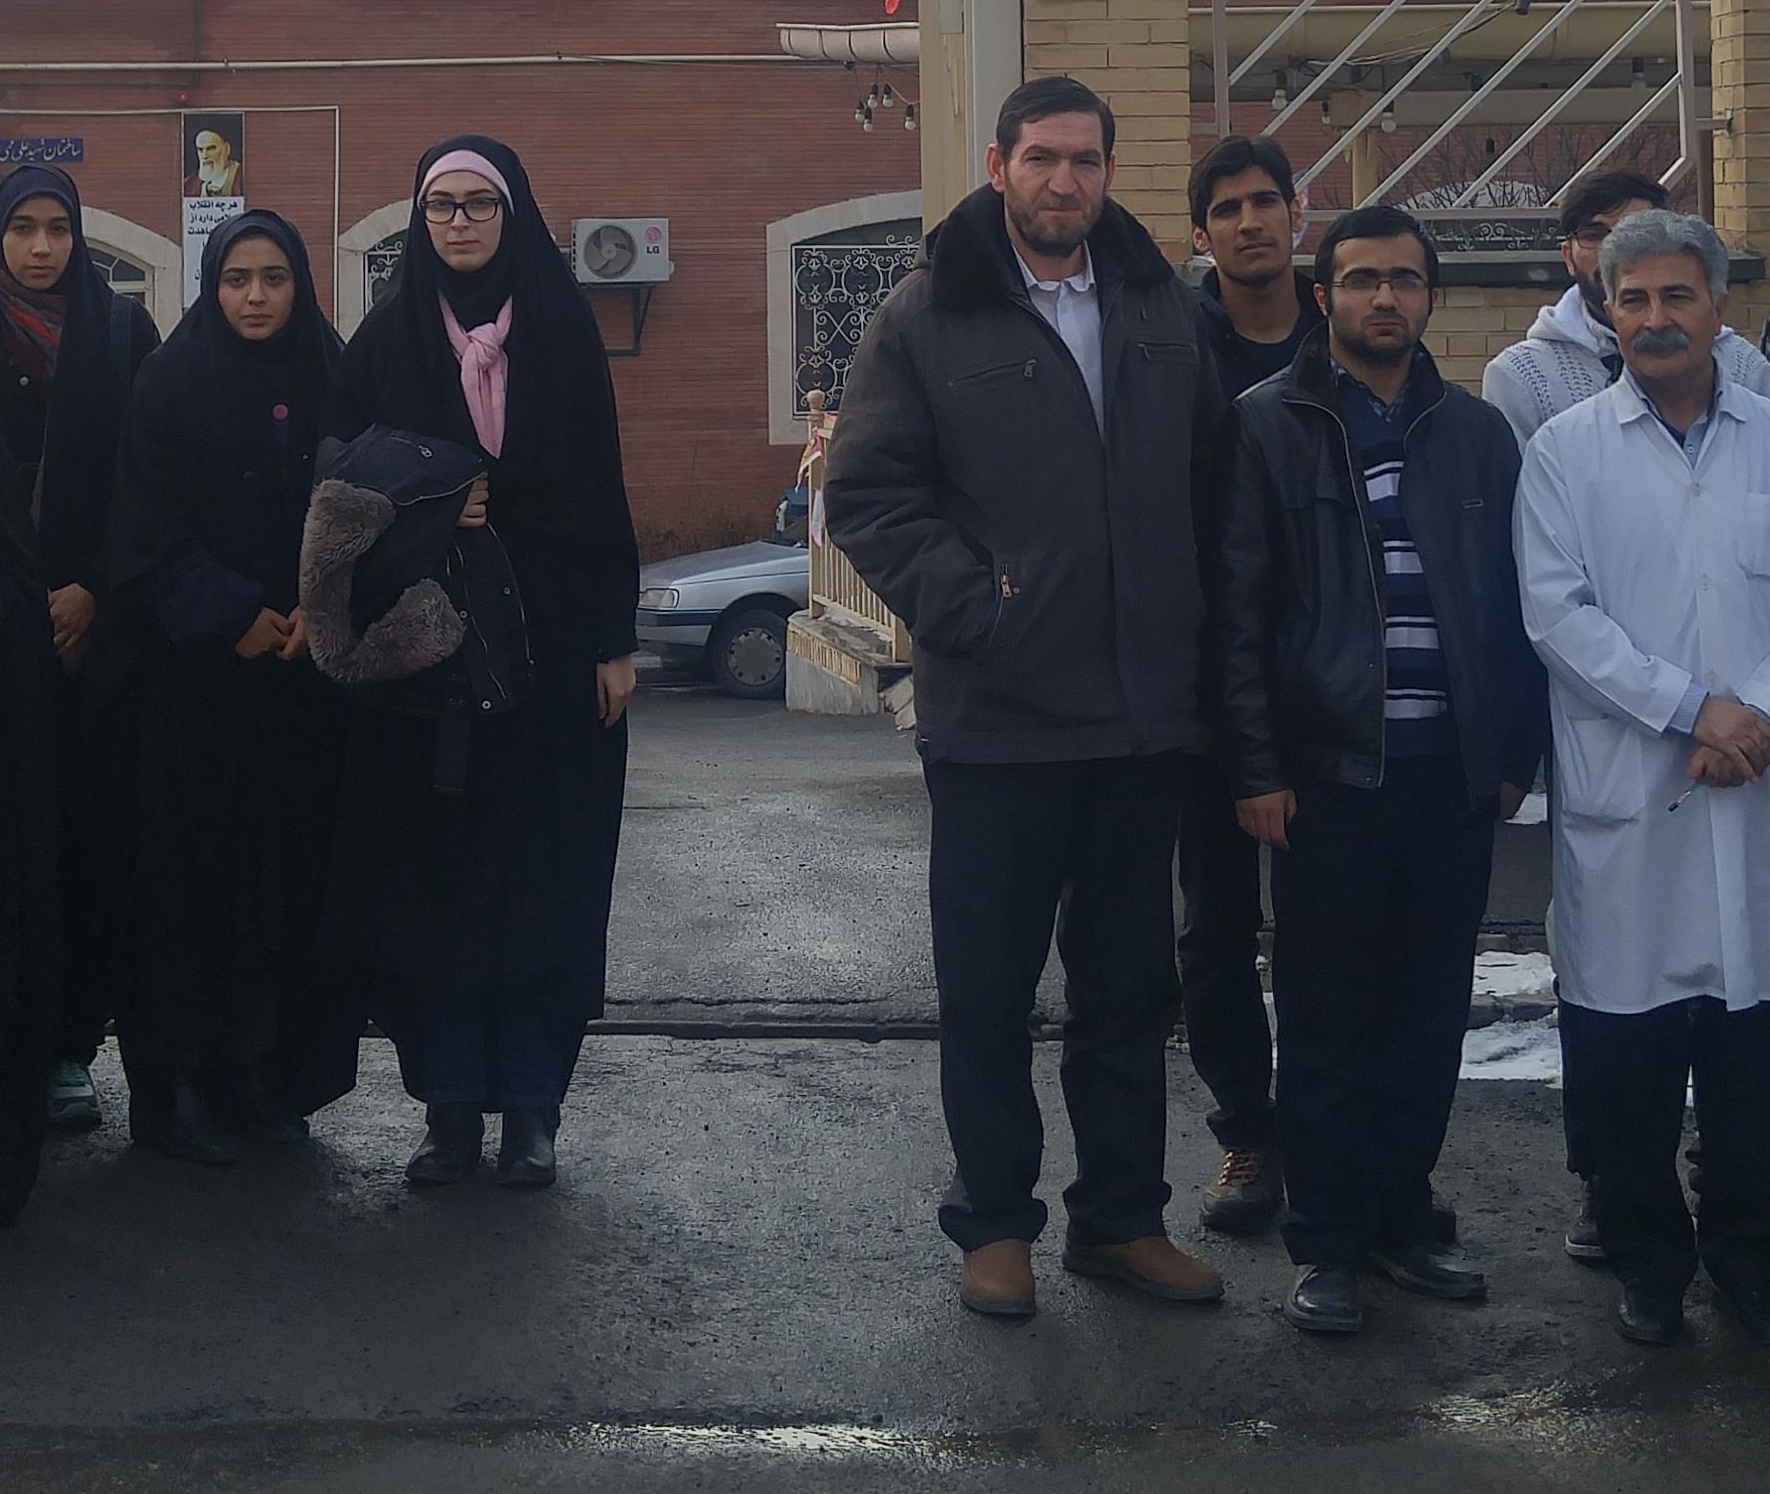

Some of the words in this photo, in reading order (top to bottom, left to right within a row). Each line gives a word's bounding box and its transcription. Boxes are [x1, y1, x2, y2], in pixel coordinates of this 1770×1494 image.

[24, 137, 47, 162] شهید
[42, 137, 82, 162] ساختمان
[189, 200, 214, 211] انقلاب
[215, 201, 226, 212] چه
[227, 200, 238, 210] هر
[646, 245, 660, 254] LG
